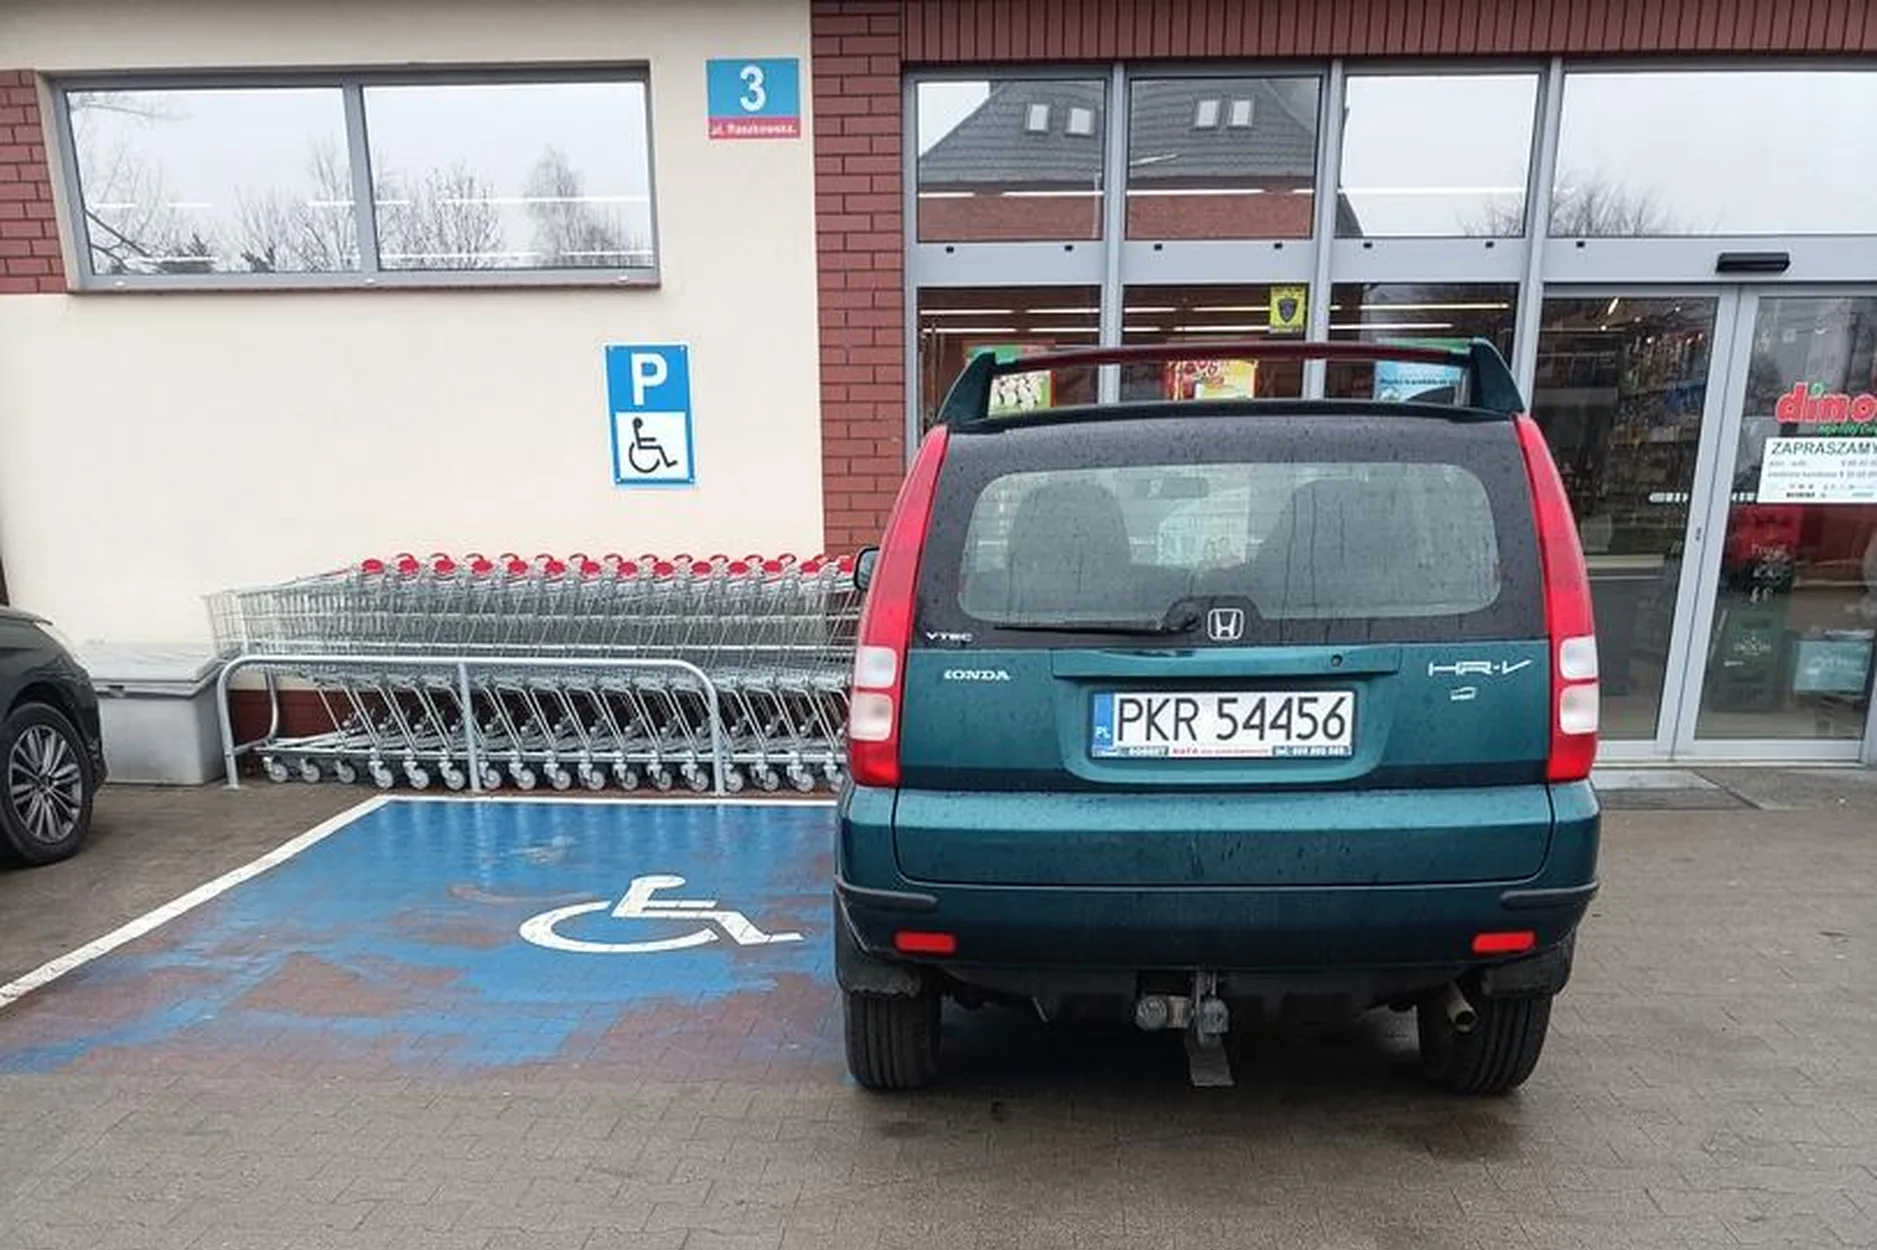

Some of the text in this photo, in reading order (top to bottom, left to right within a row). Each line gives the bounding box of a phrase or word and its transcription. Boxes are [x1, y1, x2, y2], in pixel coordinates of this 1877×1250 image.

[740, 65, 766, 112] 3
[631, 352, 668, 406] P
[1775, 381, 1877, 424] dino
[926, 632, 973, 642] VTEC
[1428, 659, 1532, 676] HR-V
[1096, 725, 1111, 739] PL
[1117, 696, 1347, 742] PKR 54456
